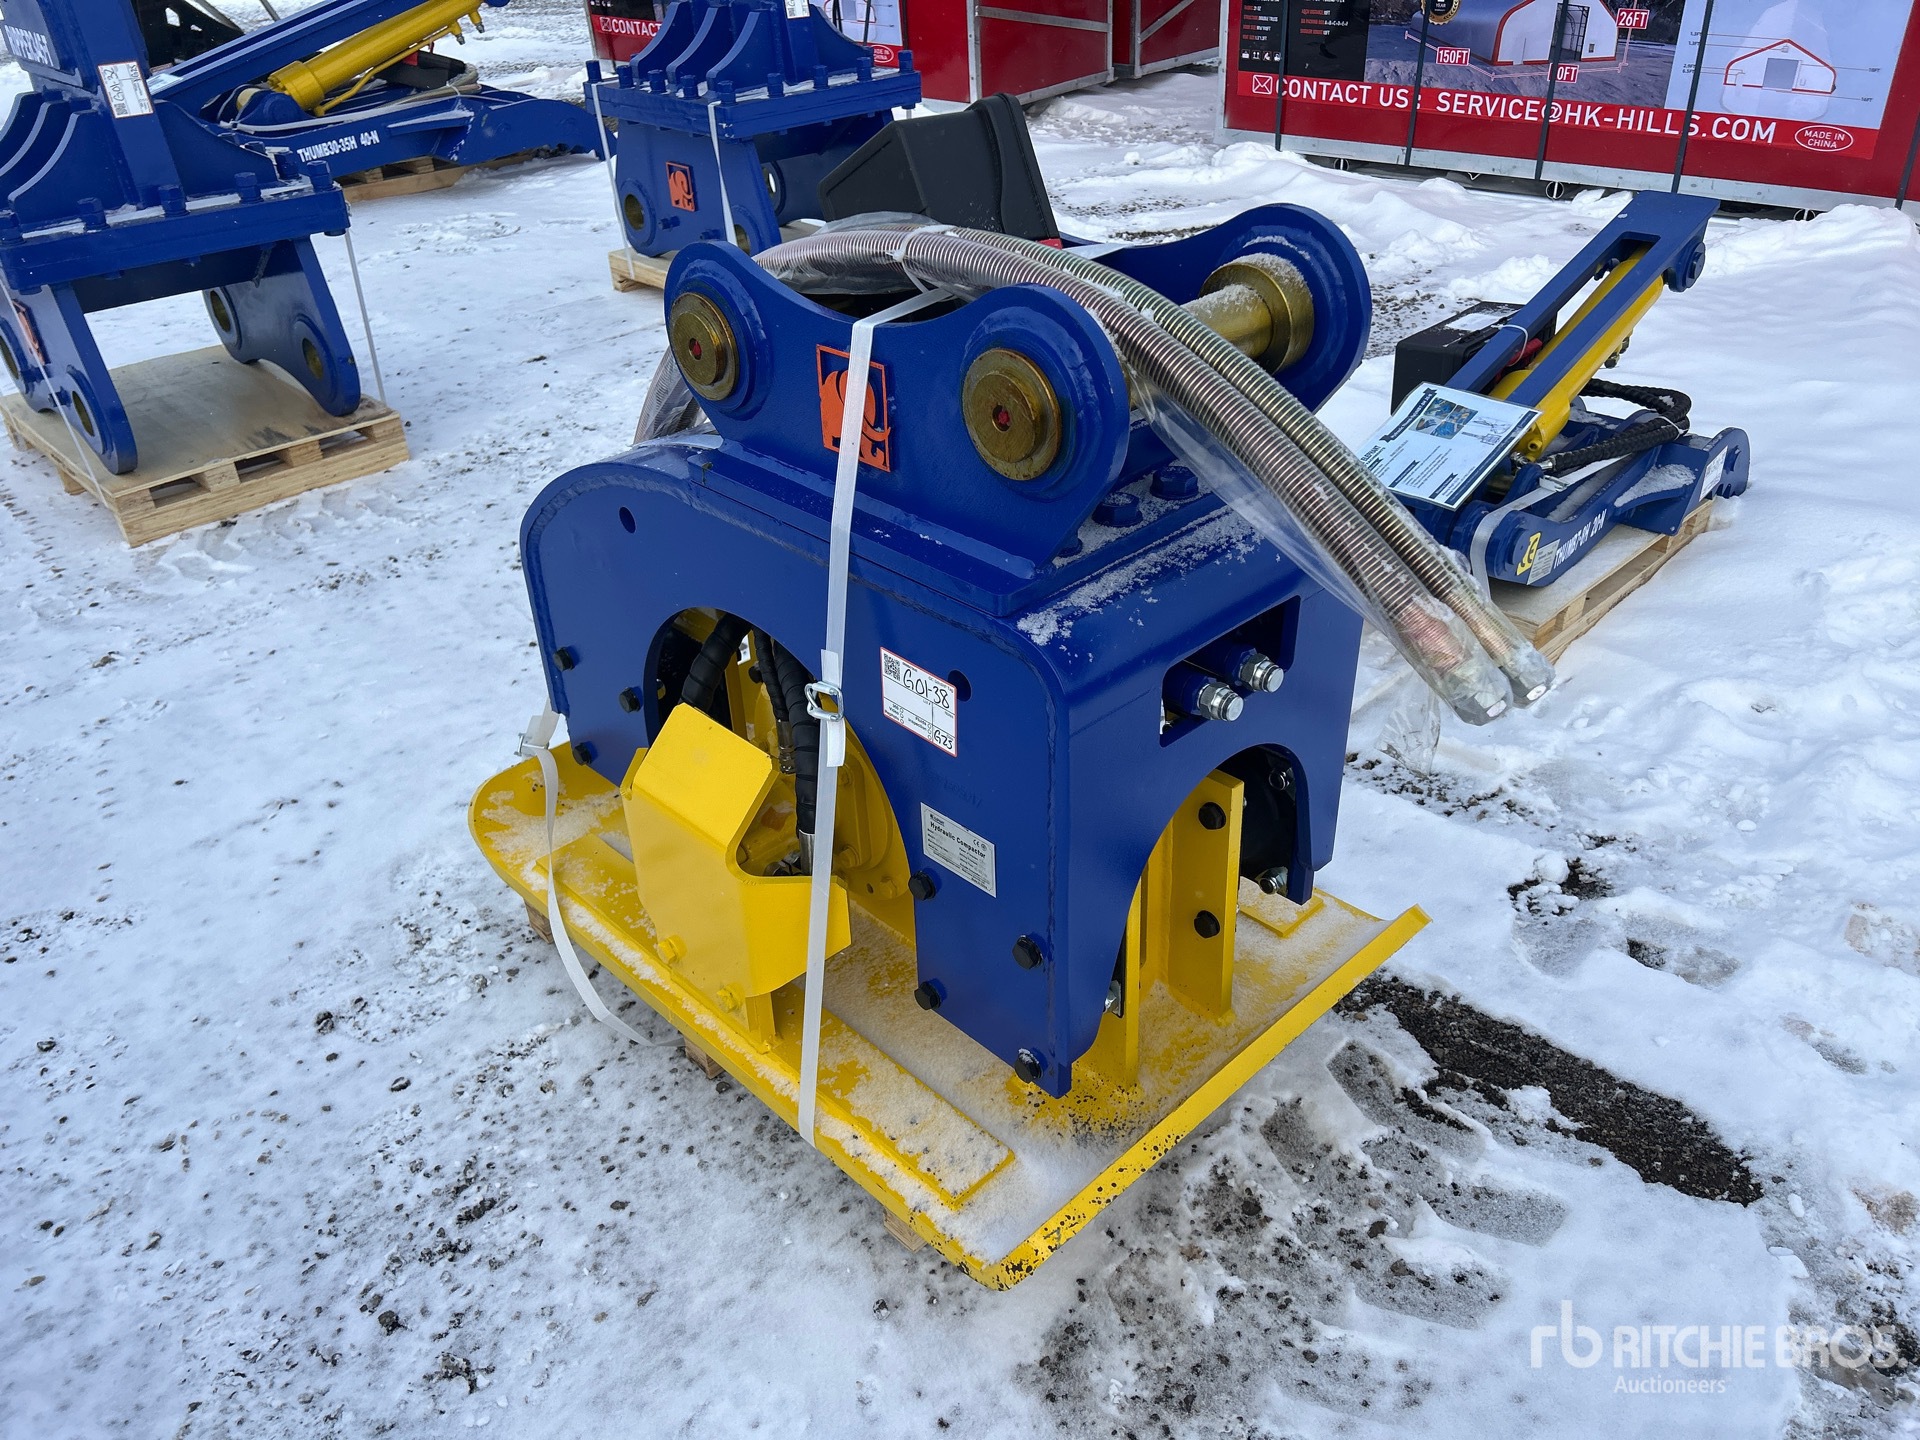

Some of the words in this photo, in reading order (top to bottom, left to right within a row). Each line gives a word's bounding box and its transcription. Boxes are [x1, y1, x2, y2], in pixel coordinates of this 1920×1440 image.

[611, 18, 662, 37] CONTACT
[1618, 11, 1648, 27] 26FT
[1438, 48, 1469, 64] 150FT
[1275, 78, 1372, 105] CONTACT
[1436, 92, 1777, 143] SERVICE@HK-HILLS.COM
[1804, 130, 1831, 140] MADE
[1834, 133, 1845, 141] IN
[1807, 139, 1838, 149] CHINA
[297, 135, 358, 163] THUMB30-35H
[930, 821, 956, 841] Hydraulic
[956, 837, 986, 859] Compactor
